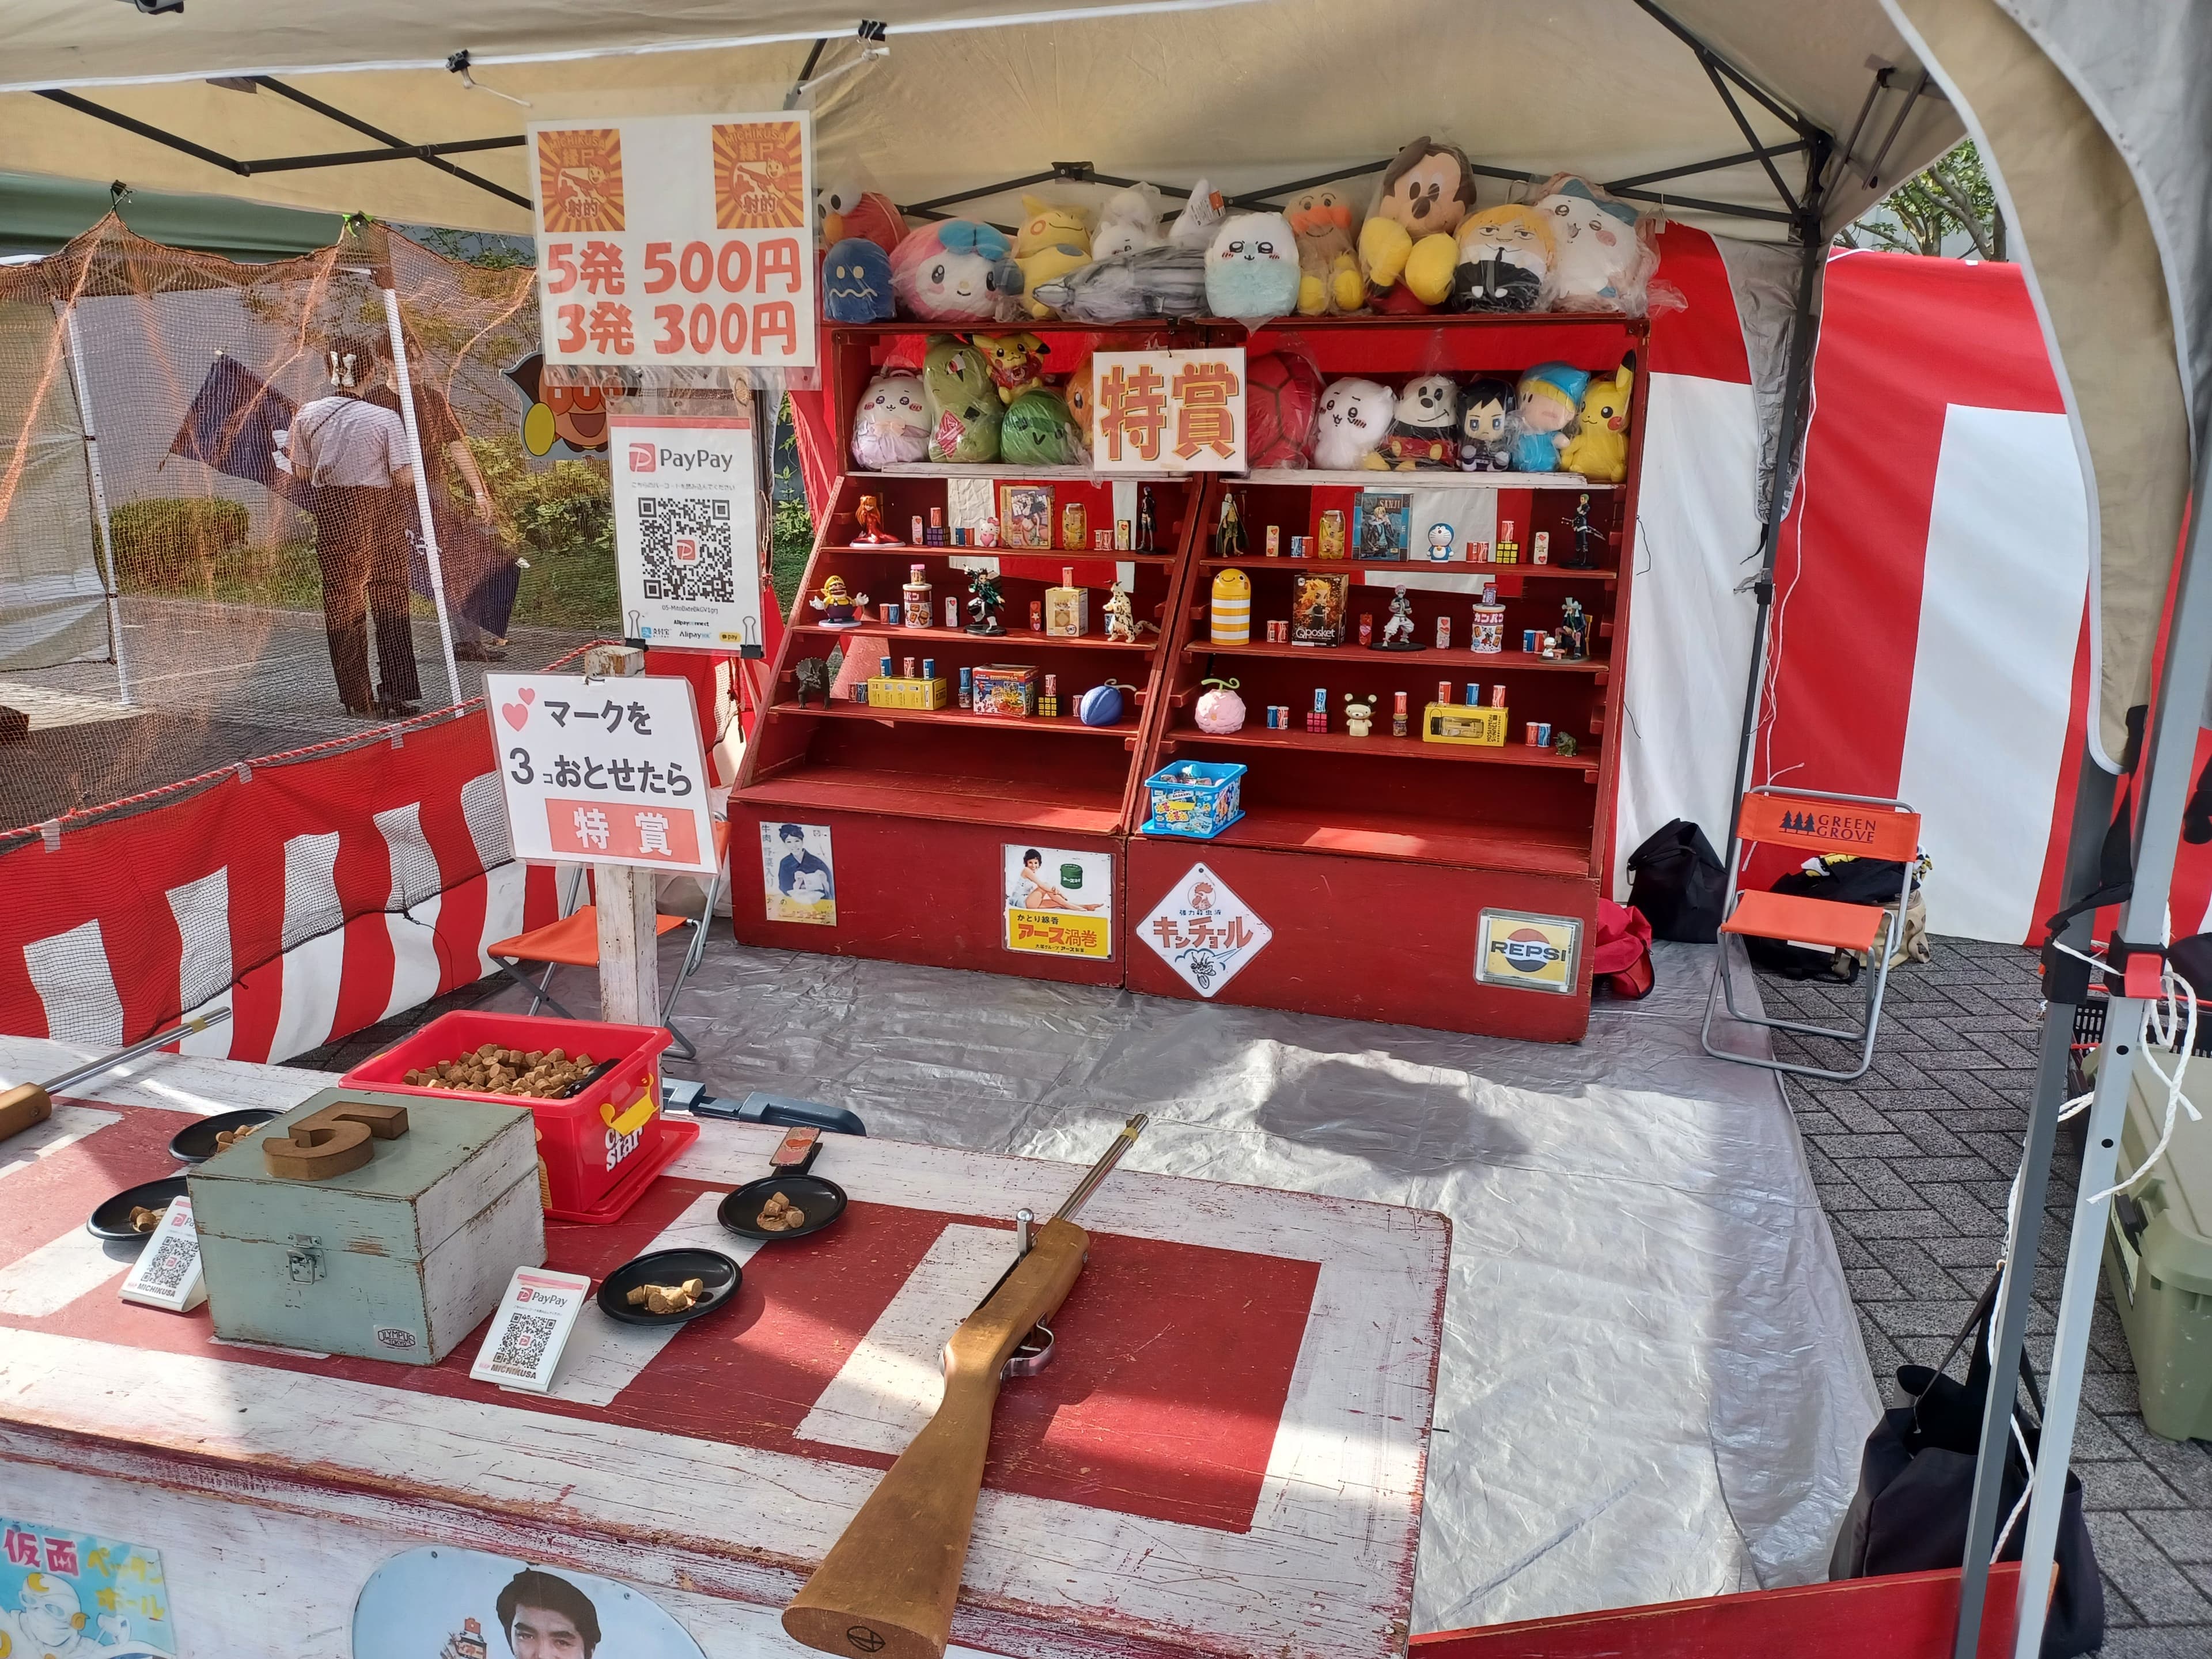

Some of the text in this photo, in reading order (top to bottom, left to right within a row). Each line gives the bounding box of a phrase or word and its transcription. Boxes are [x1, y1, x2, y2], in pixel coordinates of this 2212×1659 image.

[725, 128, 787, 145] MICHIKUSA
[547, 237, 802, 295] 5発 500円
[557, 300, 797, 355] 3発 300円
[1099, 363, 1238, 461] 特賞
[660, 449, 733, 472] PayPay
[1380, 499, 1400, 509] SANJI
[1474, 612, 1503, 623] カンパン
[544, 699, 652, 735] マークを
[573, 806, 672, 856] 特賞
[1818, 814, 1876, 832] GREEN
[1816, 826, 1874, 843] GROVE
[1017, 914, 1059, 925] かとり線香
[1018, 923, 1097, 948] アース渦巻
[1153, 916, 1253, 949] キンチョール
[137, 1283, 176, 1297] MICHIKUSA
[532, 1291, 567, 1308] PayPay
[378, 1329, 415, 1345] OLYMPUS
[491, 1364, 536, 1379] MICHIKUSA
[3, 1529, 79, 1577] 仮面
